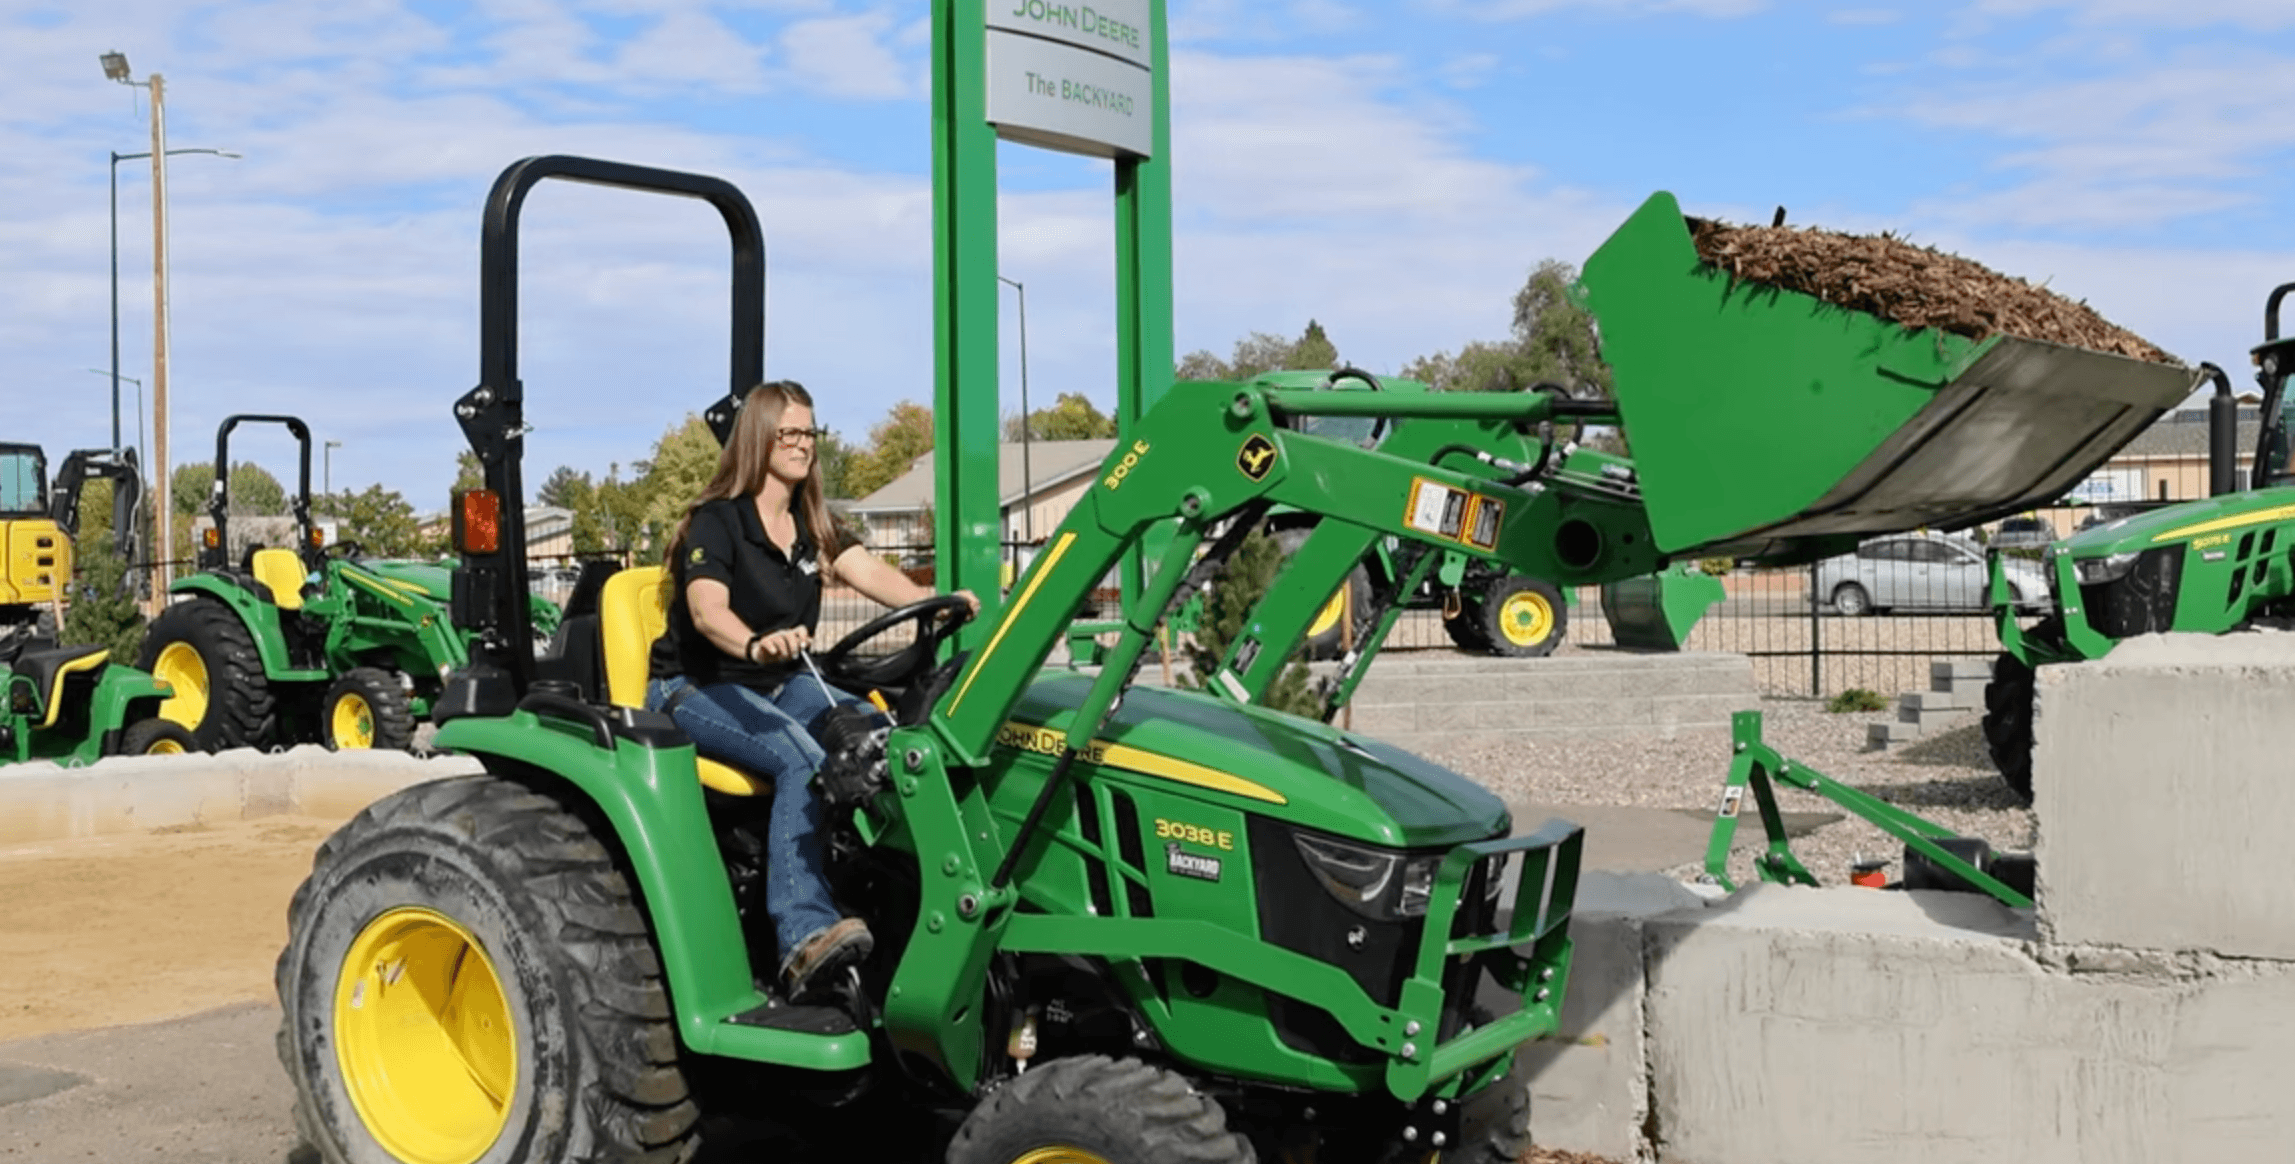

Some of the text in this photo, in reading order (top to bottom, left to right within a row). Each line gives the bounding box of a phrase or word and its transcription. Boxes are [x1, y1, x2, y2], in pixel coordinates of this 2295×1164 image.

[1013, 0, 1140, 49] JOHN DEERE
[1025, 71, 1134, 118] The BACKYARD
[999, 726, 1104, 763] OHN DERE
